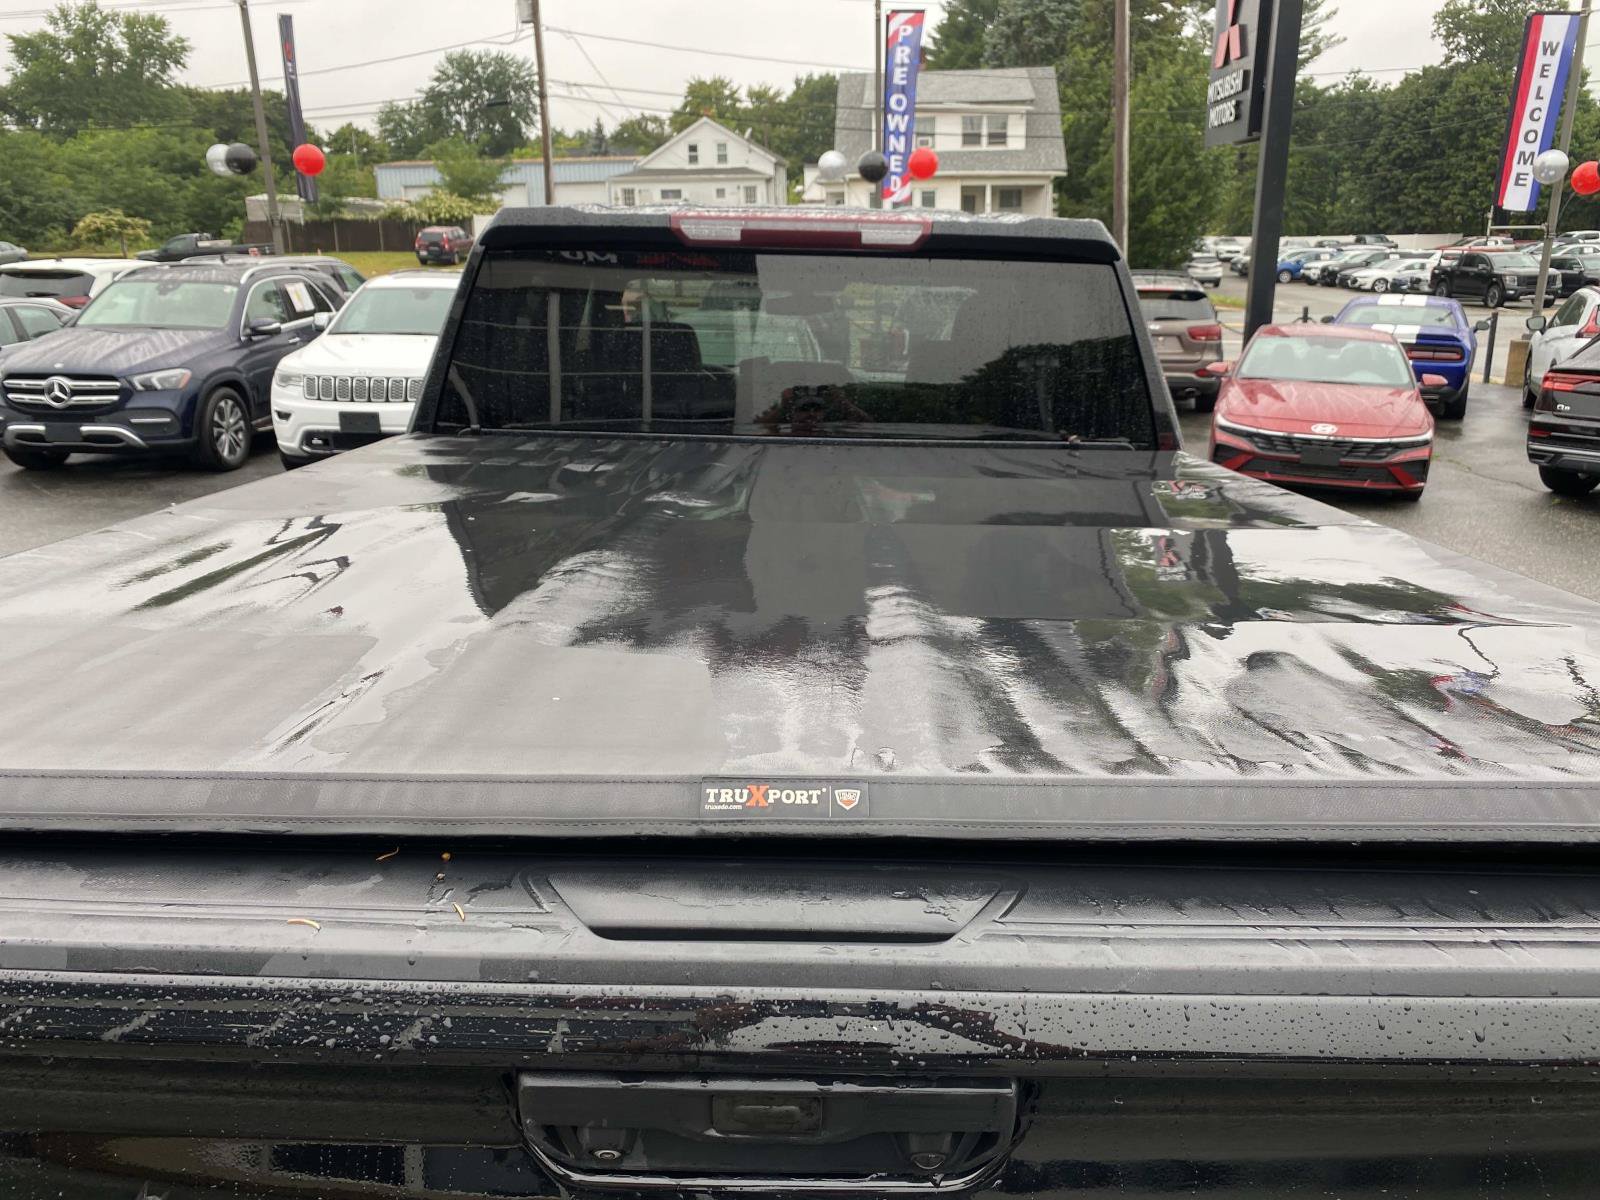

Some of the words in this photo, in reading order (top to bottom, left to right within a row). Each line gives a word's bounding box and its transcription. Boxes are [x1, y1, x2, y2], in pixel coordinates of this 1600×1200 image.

[892, 25, 914, 86] PRE
[1207, 69, 1244, 104] MITSUBISHI
[1209, 99, 1237, 128] MOTORS
[1513, 40, 1561, 187] WELCOME
[887, 93, 910, 192] OWNED
